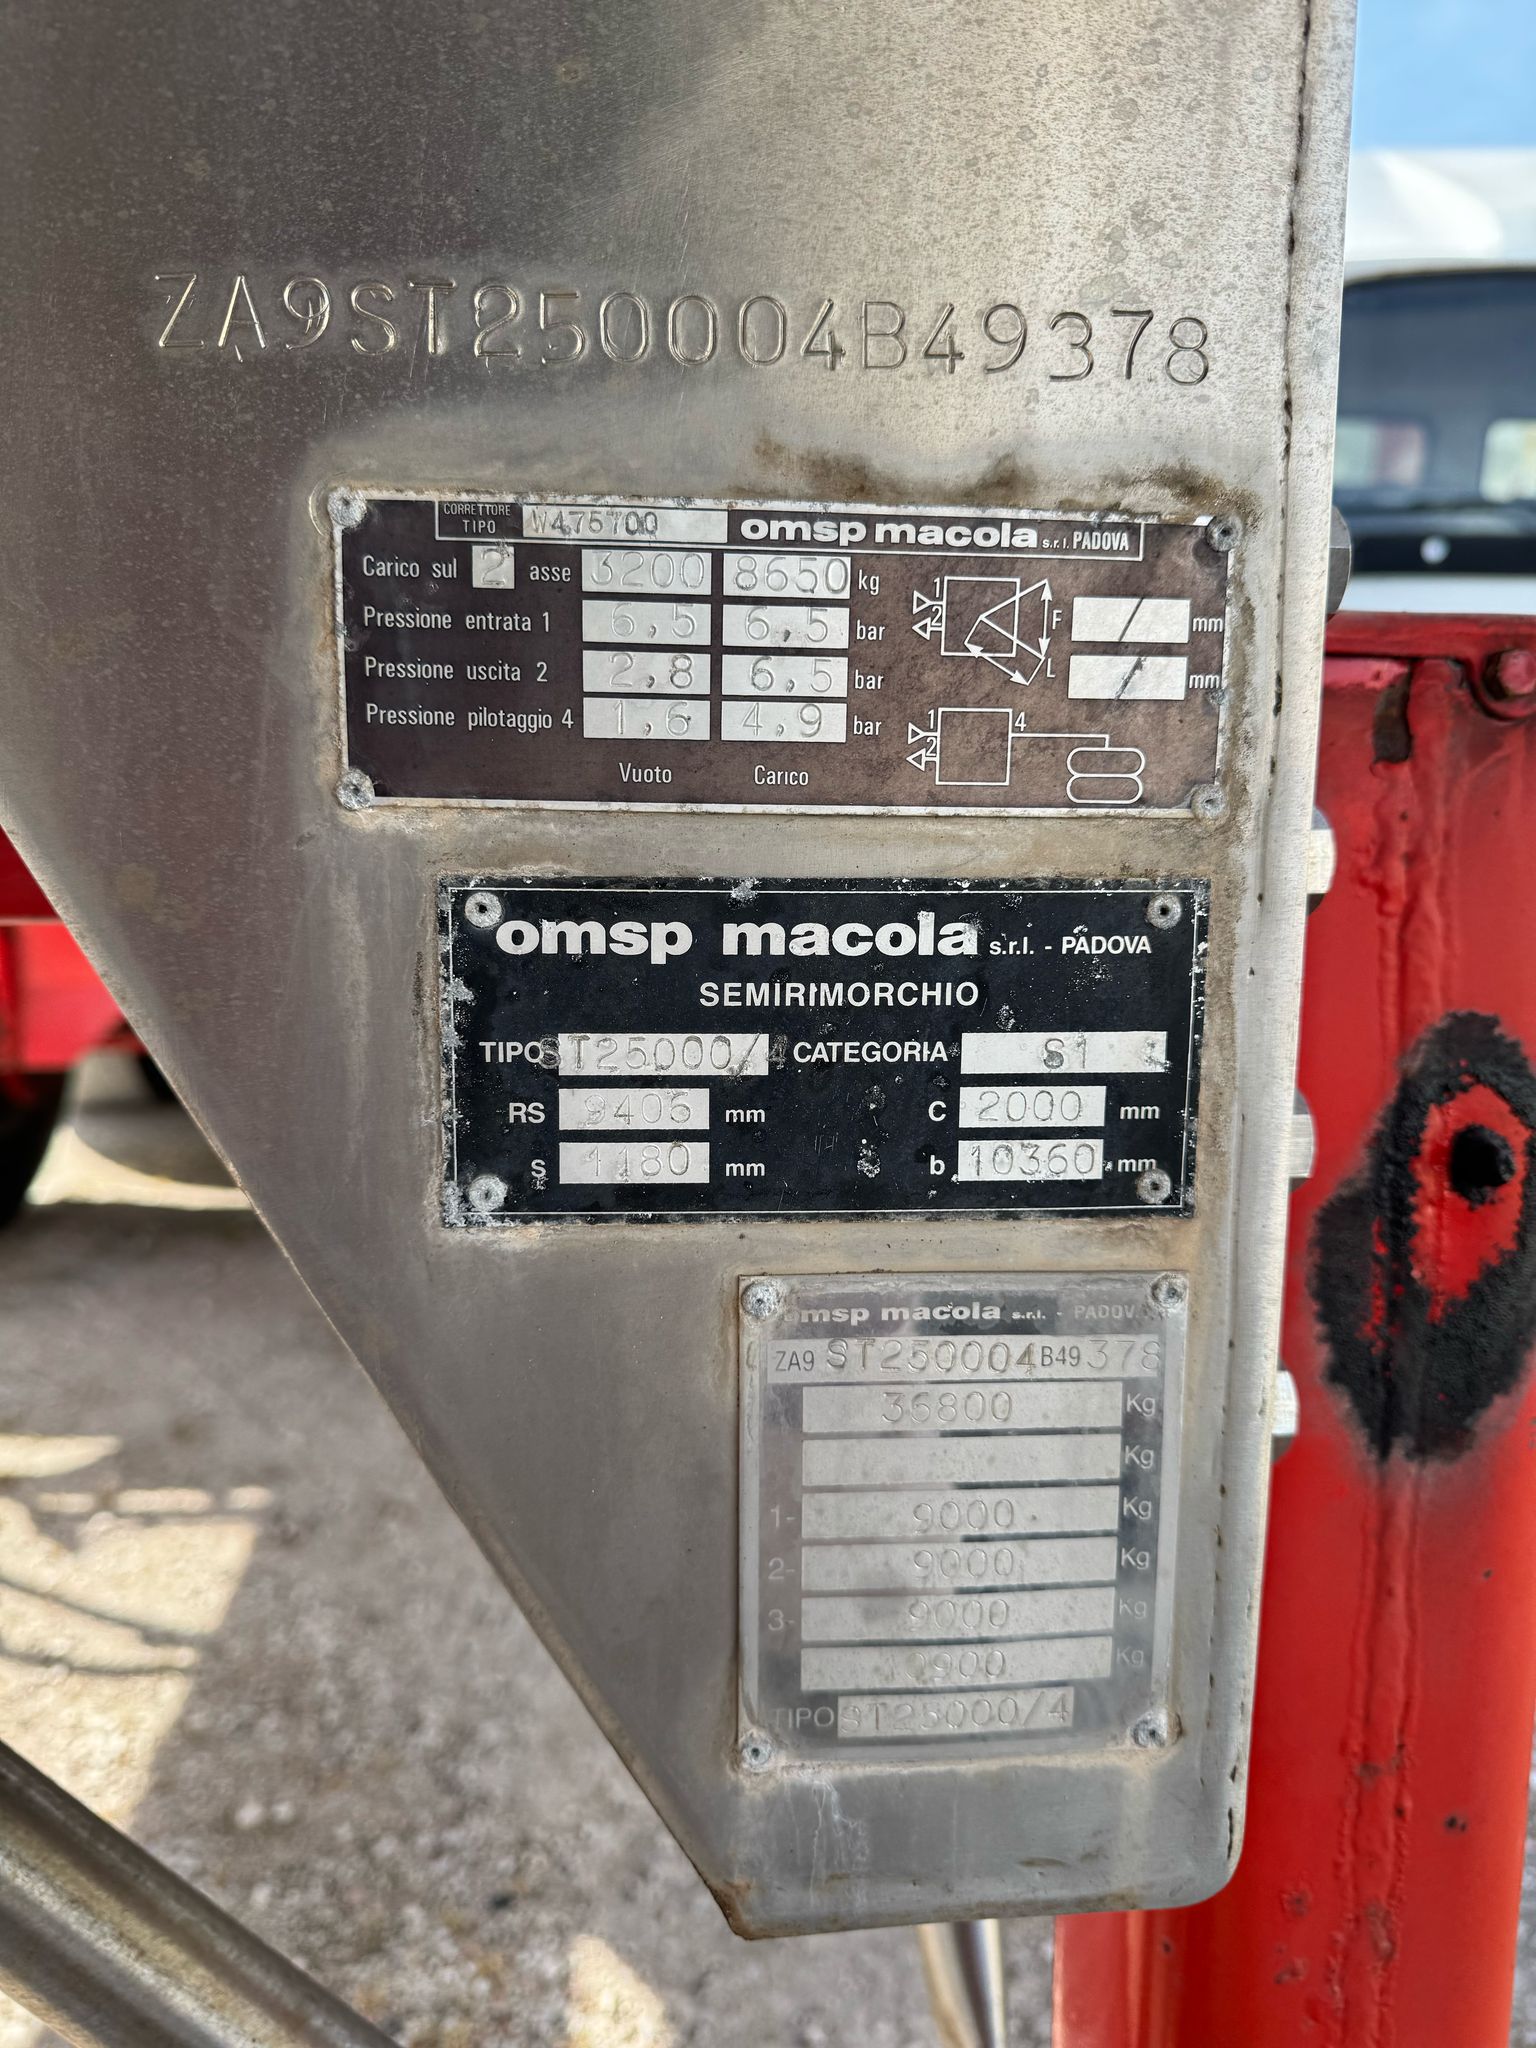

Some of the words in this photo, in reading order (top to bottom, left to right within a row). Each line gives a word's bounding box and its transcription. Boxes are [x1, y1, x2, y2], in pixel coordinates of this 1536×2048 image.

[153, 272, 1211, 387] ZA9ST250004B49378
[443, 503, 511, 516] CORRETTORE
[462, 519, 496, 534] TIPO
[740, 517, 872, 547] omsp
[875, 521, 1038, 549] macola
[1072, 533, 1130, 551] PADOVA
[363, 555, 420, 579] Carico
[432, 557, 458, 580] sul
[480, 550, 507, 587] 2
[529, 565, 571, 583] asse
[590, 551, 706, 590] 3200
[734, 556, 850, 594] 8650
[858, 572, 881, 596] kg
[932, 577, 942, 598] 1
[363, 606, 452, 630] Pressione
[465, 611, 532, 633] entrata
[541, 611, 551, 633] 1
[611, 602, 696, 639] 6,5
[744, 606, 830, 643] 6,5
[856, 622, 886, 641] bar
[931, 607, 943, 626] 2
[1052, 609, 1063, 630] F
[1192, 617, 1224, 632] mm
[364, 656, 454, 680] Pressione
[466, 661, 522, 682] uscita
[536, 662, 548, 683] 2
[609, 652, 694, 689] 2,8
[749, 656, 833, 694] 6,5
[854, 671, 884, 691] bar
[1046, 658, 1056, 678] L
[1188, 674, 1220, 689] mm
[365, 703, 456, 726] Pressione
[467, 707, 553, 731] pilotaggio
[561, 709, 575, 729] 4
[613, 701, 692, 737] 1,6
[741, 703, 824, 738] 4,9
[853, 717, 883, 737] bar
[927, 709, 936, 730] 1
[1014, 711, 1027, 730] 4
[925, 738, 937, 757] 2
[618, 762, 673, 784] Vuoto
[754, 765, 810, 787] Carico
[496, 920, 693, 964] omsp
[722, 911, 979, 957] macola
[989, 937, 1035, 955] s.r.l.
[1061, 936, 1152, 955] PADOVA
[699, 981, 979, 1007] SEMIRIMORCHIO
[479, 1041, 543, 1063] TIPO
[793, 1041, 948, 1063] CATEGORIA
[508, 1102, 546, 1123] RS
[725, 1108, 766, 1123] mm
[978, 1090, 1083, 1123] 2000
[1119, 1103, 1160, 1120] mm
[531, 1158, 547, 1178] S
[581, 1143, 691, 1178] 1180
[725, 1161, 766, 1177] mm
[929, 1156, 946, 1176] b
[969, 1141, 1097, 1177] 10360
[1117, 1156, 1158, 1173] mm
[881, 1302, 1002, 1323] macola
[1074, 1304, 1148, 1320] PADOV
[881, 1391, 1014, 1424] 36800
[1127, 1393, 1157, 1416] Kg
[1125, 1445, 1155, 1468] Kg
[912, 1498, 1015, 1532] 9000
[1122, 1498, 1153, 1520] Kg
[1121, 1548, 1150, 1570] Kg
[1118, 1598, 1148, 1620] Kg
[1116, 1647, 1145, 1668] Kg
[773, 1706, 834, 1729] TIPO
